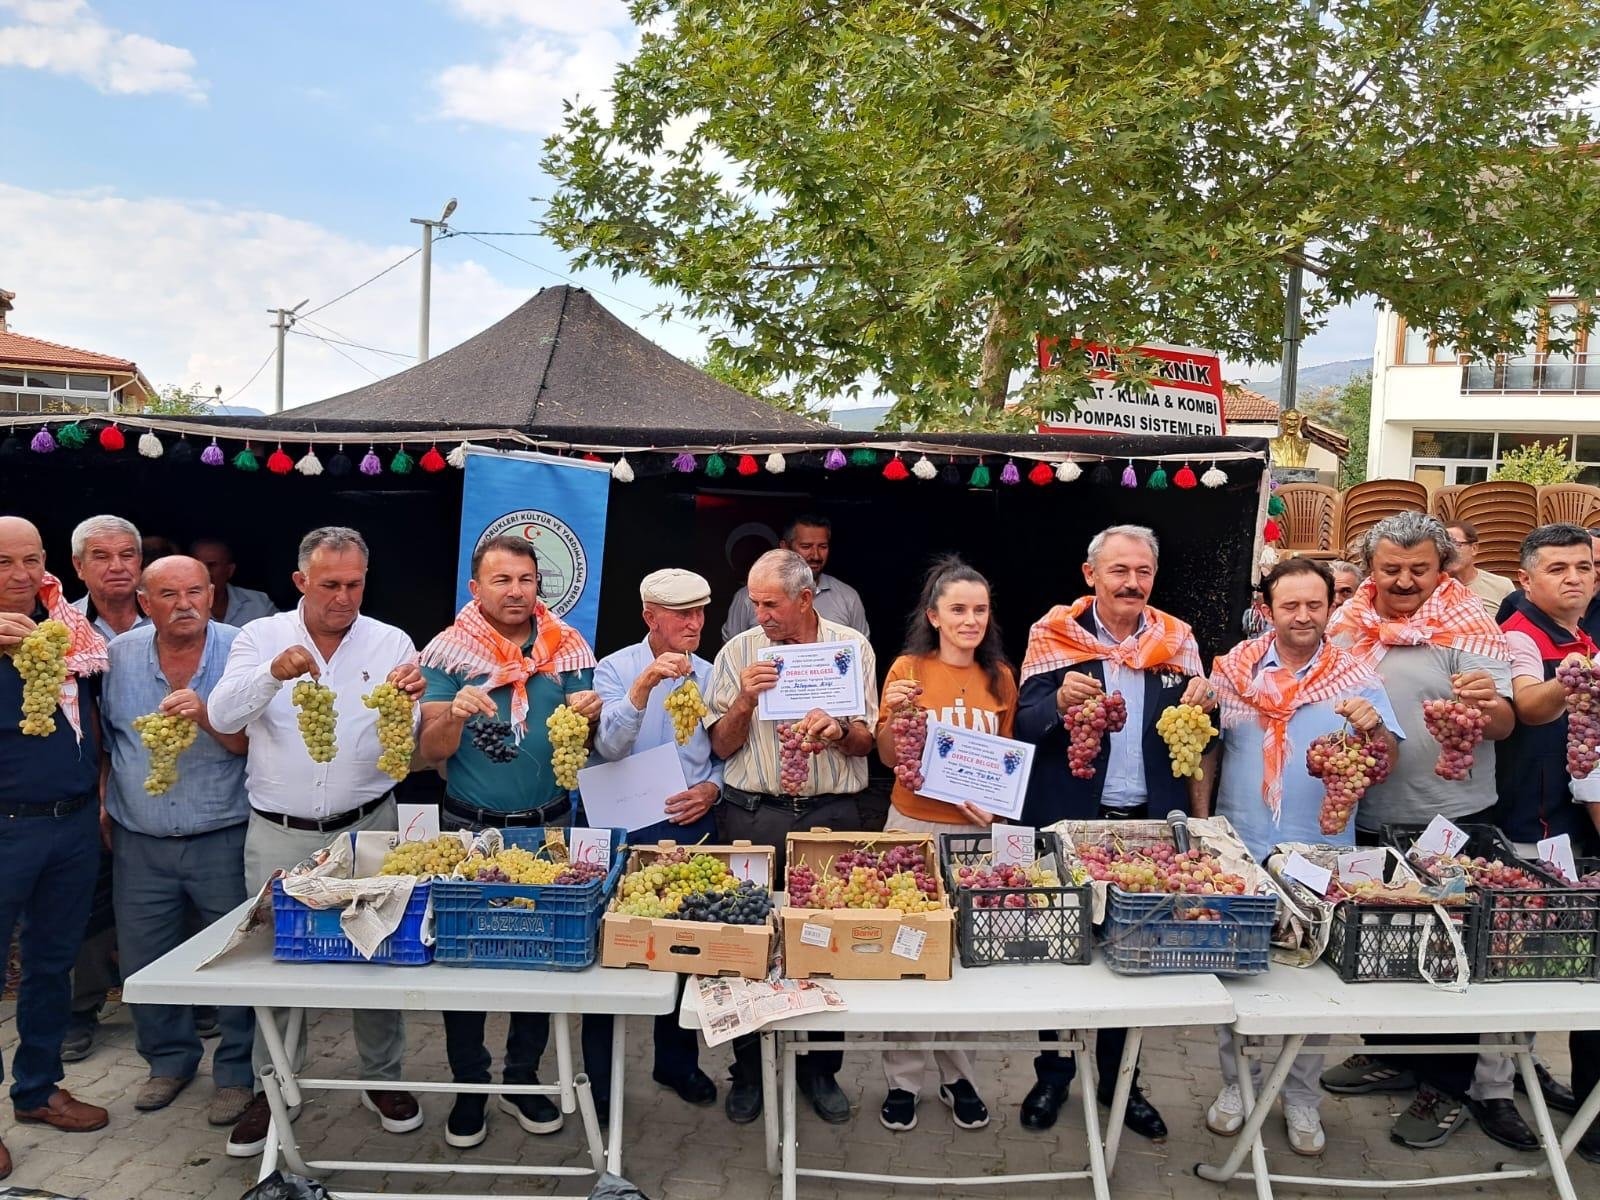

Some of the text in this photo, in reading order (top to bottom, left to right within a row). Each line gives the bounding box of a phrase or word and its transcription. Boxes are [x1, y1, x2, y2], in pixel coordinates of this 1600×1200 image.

[1177, 396, 1217, 416] KOMBİ
[1074, 410, 1135, 429] POMPASI
[1140, 414, 1216, 436] SİSTEMLERİ
[553, 521, 564, 531] VE
[853, 929, 880, 938] Banvit
